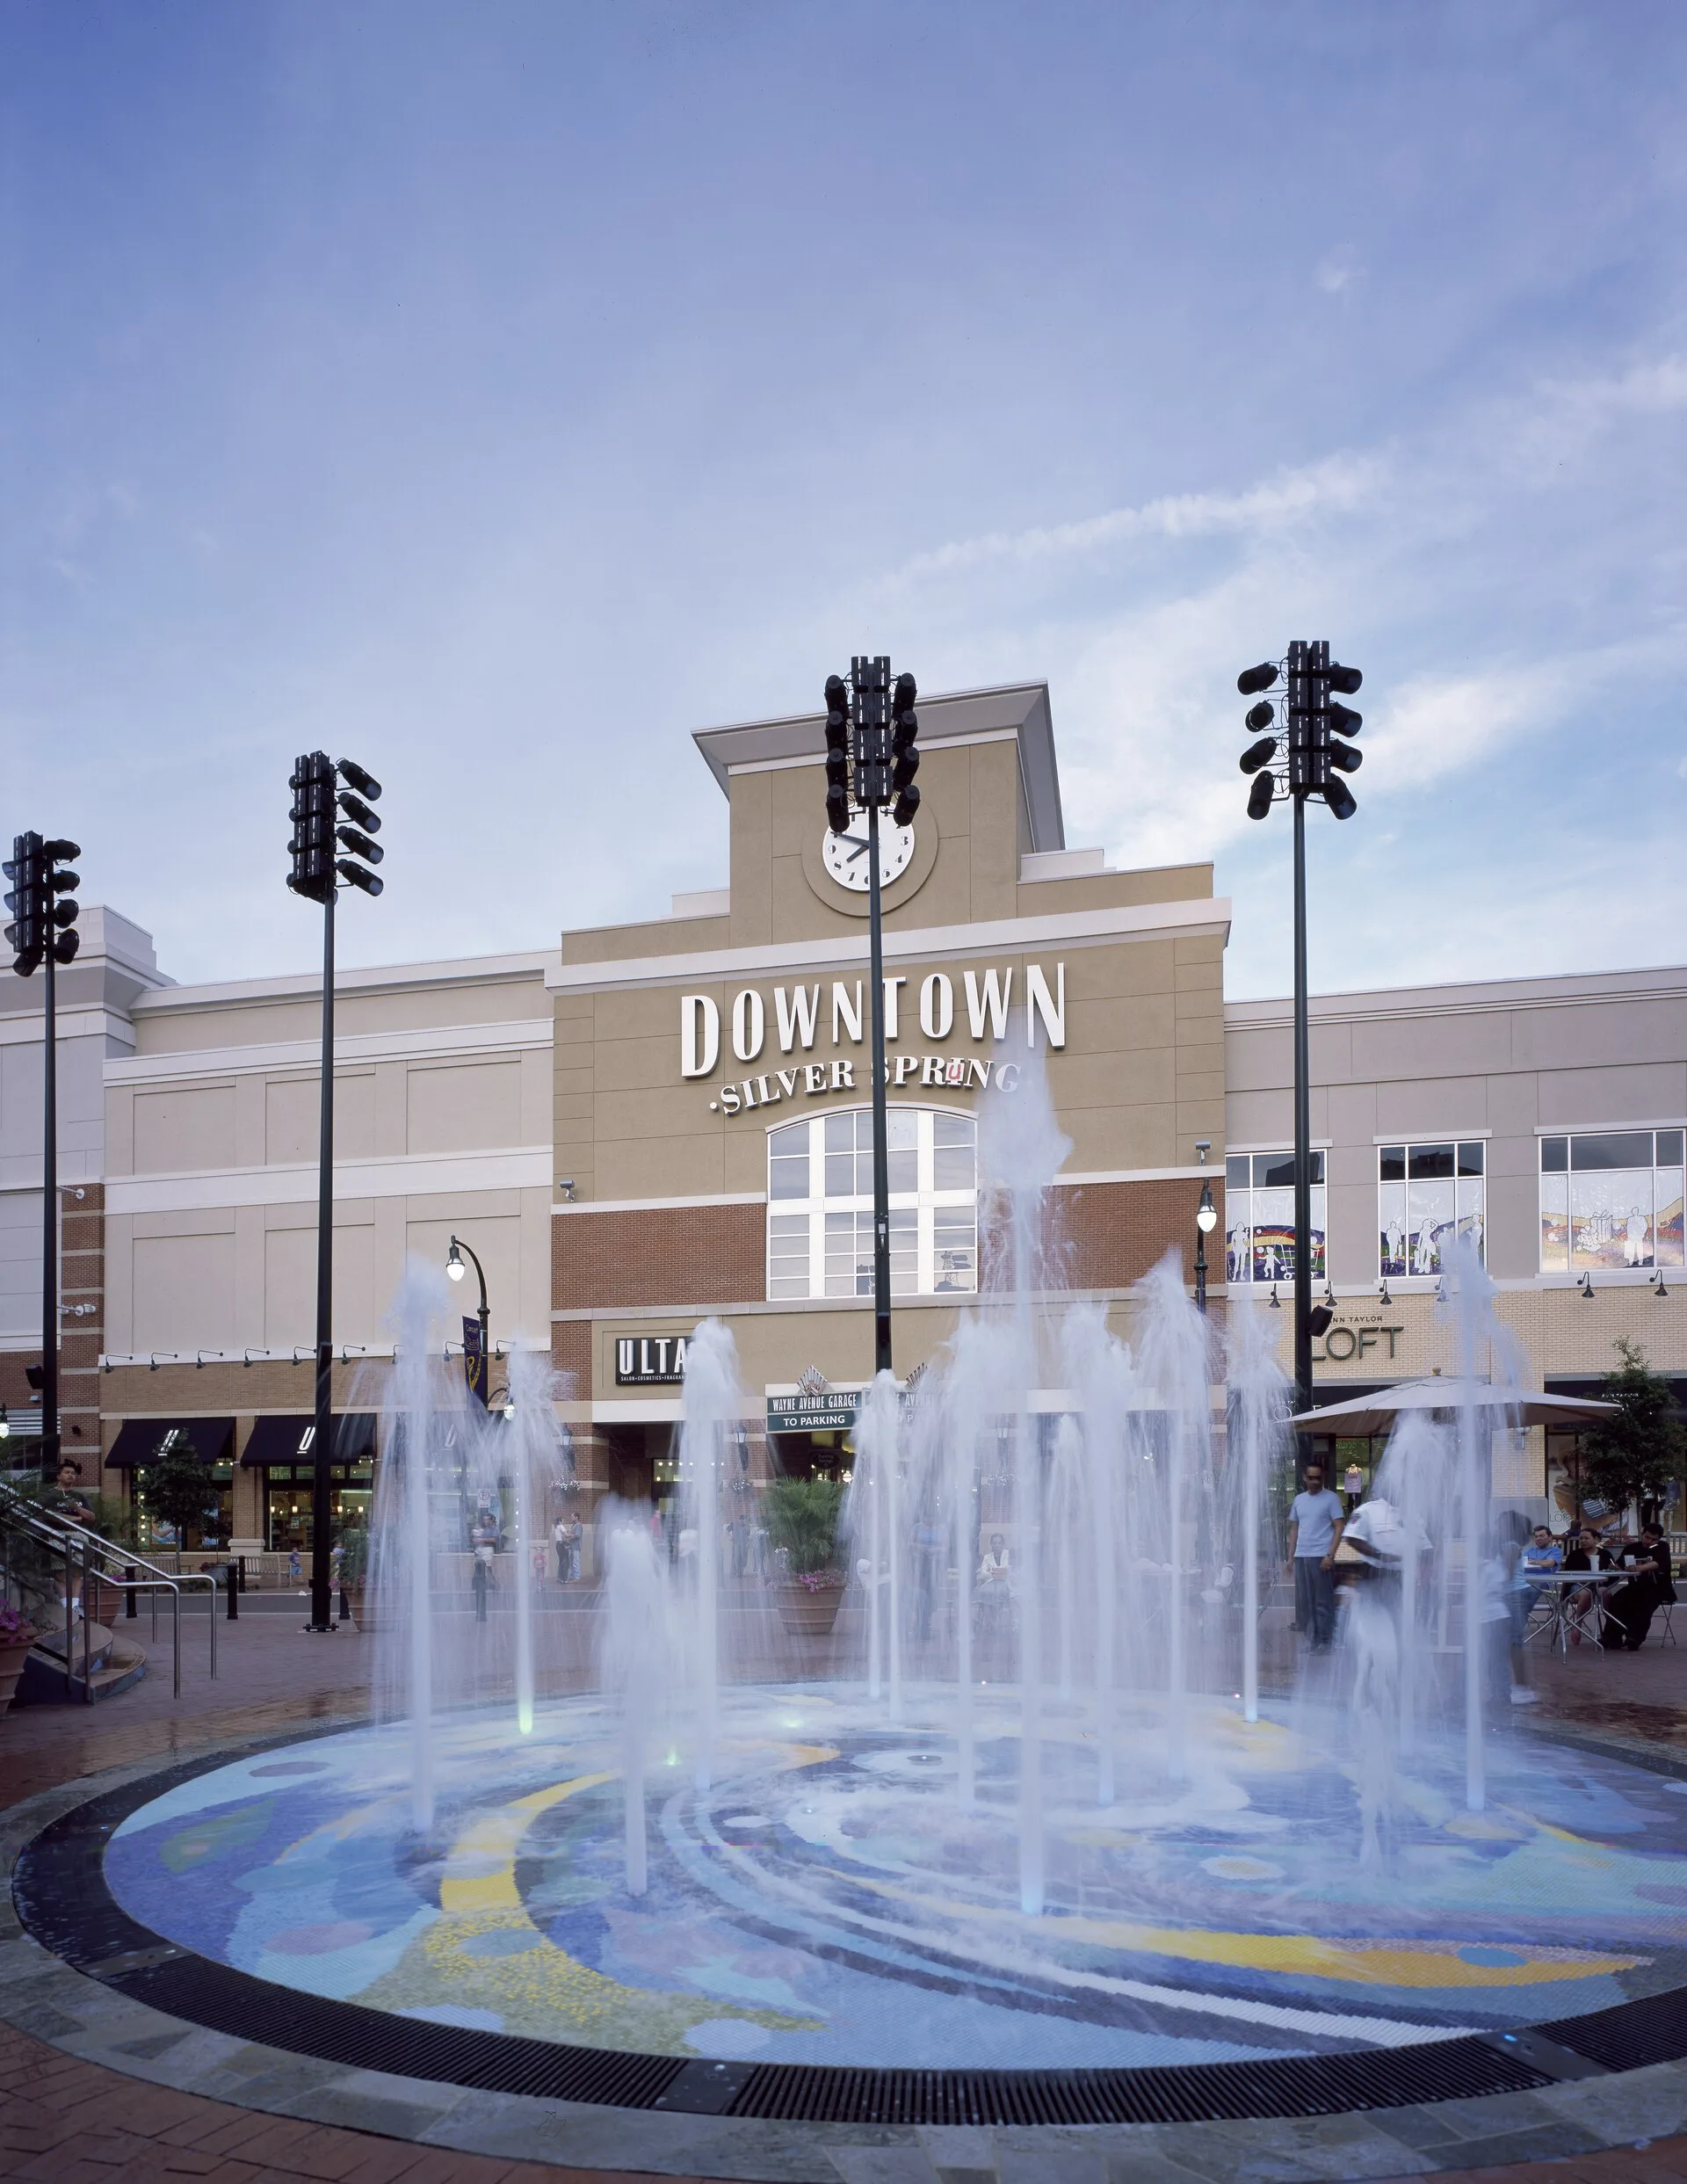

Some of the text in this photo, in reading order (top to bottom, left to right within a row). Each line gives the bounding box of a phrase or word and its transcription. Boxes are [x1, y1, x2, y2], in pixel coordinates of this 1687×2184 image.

[681, 962, 1066, 1077] DOWNTOWN
[720, 1060, 856, 1116] SILVER
[619, 1338, 687, 1375] ULTA
[772, 1394, 857, 1411] WAYNE AVENUE GARAGE
[783, 1415, 845, 1427] TO PARKING
